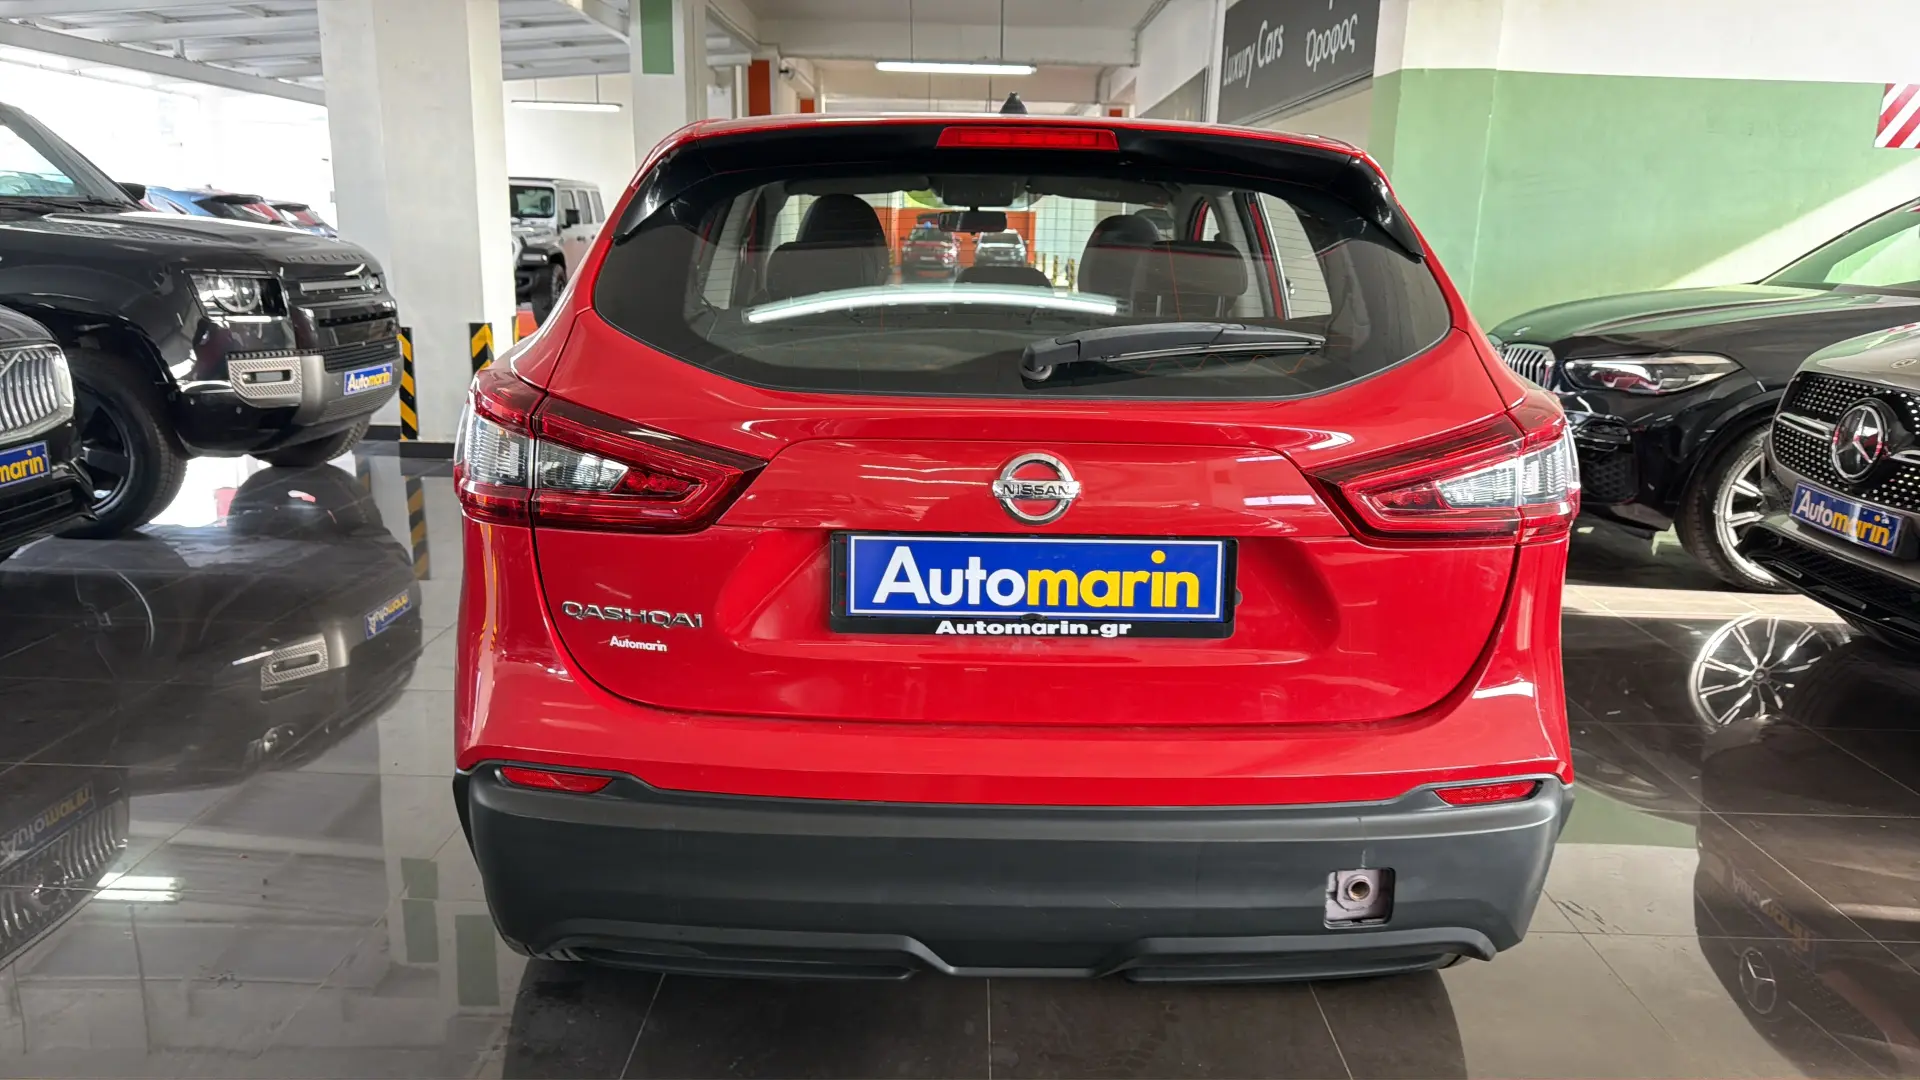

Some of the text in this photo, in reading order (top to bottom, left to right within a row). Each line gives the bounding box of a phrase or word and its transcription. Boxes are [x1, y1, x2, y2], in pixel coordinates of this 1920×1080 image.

[1223, 19, 1284, 88] Luxury Cars
[347, 367, 390, 391] Automarin
[1002, 484, 1071, 496] NISSAN
[1796, 490, 1890, 546] Automarin
[872, 545, 1200, 609] Automarin
[561, 600, 703, 628] QASHQAI
[935, 619, 1132, 638] Automarin.gr
[609, 635, 668, 652] Automarin
